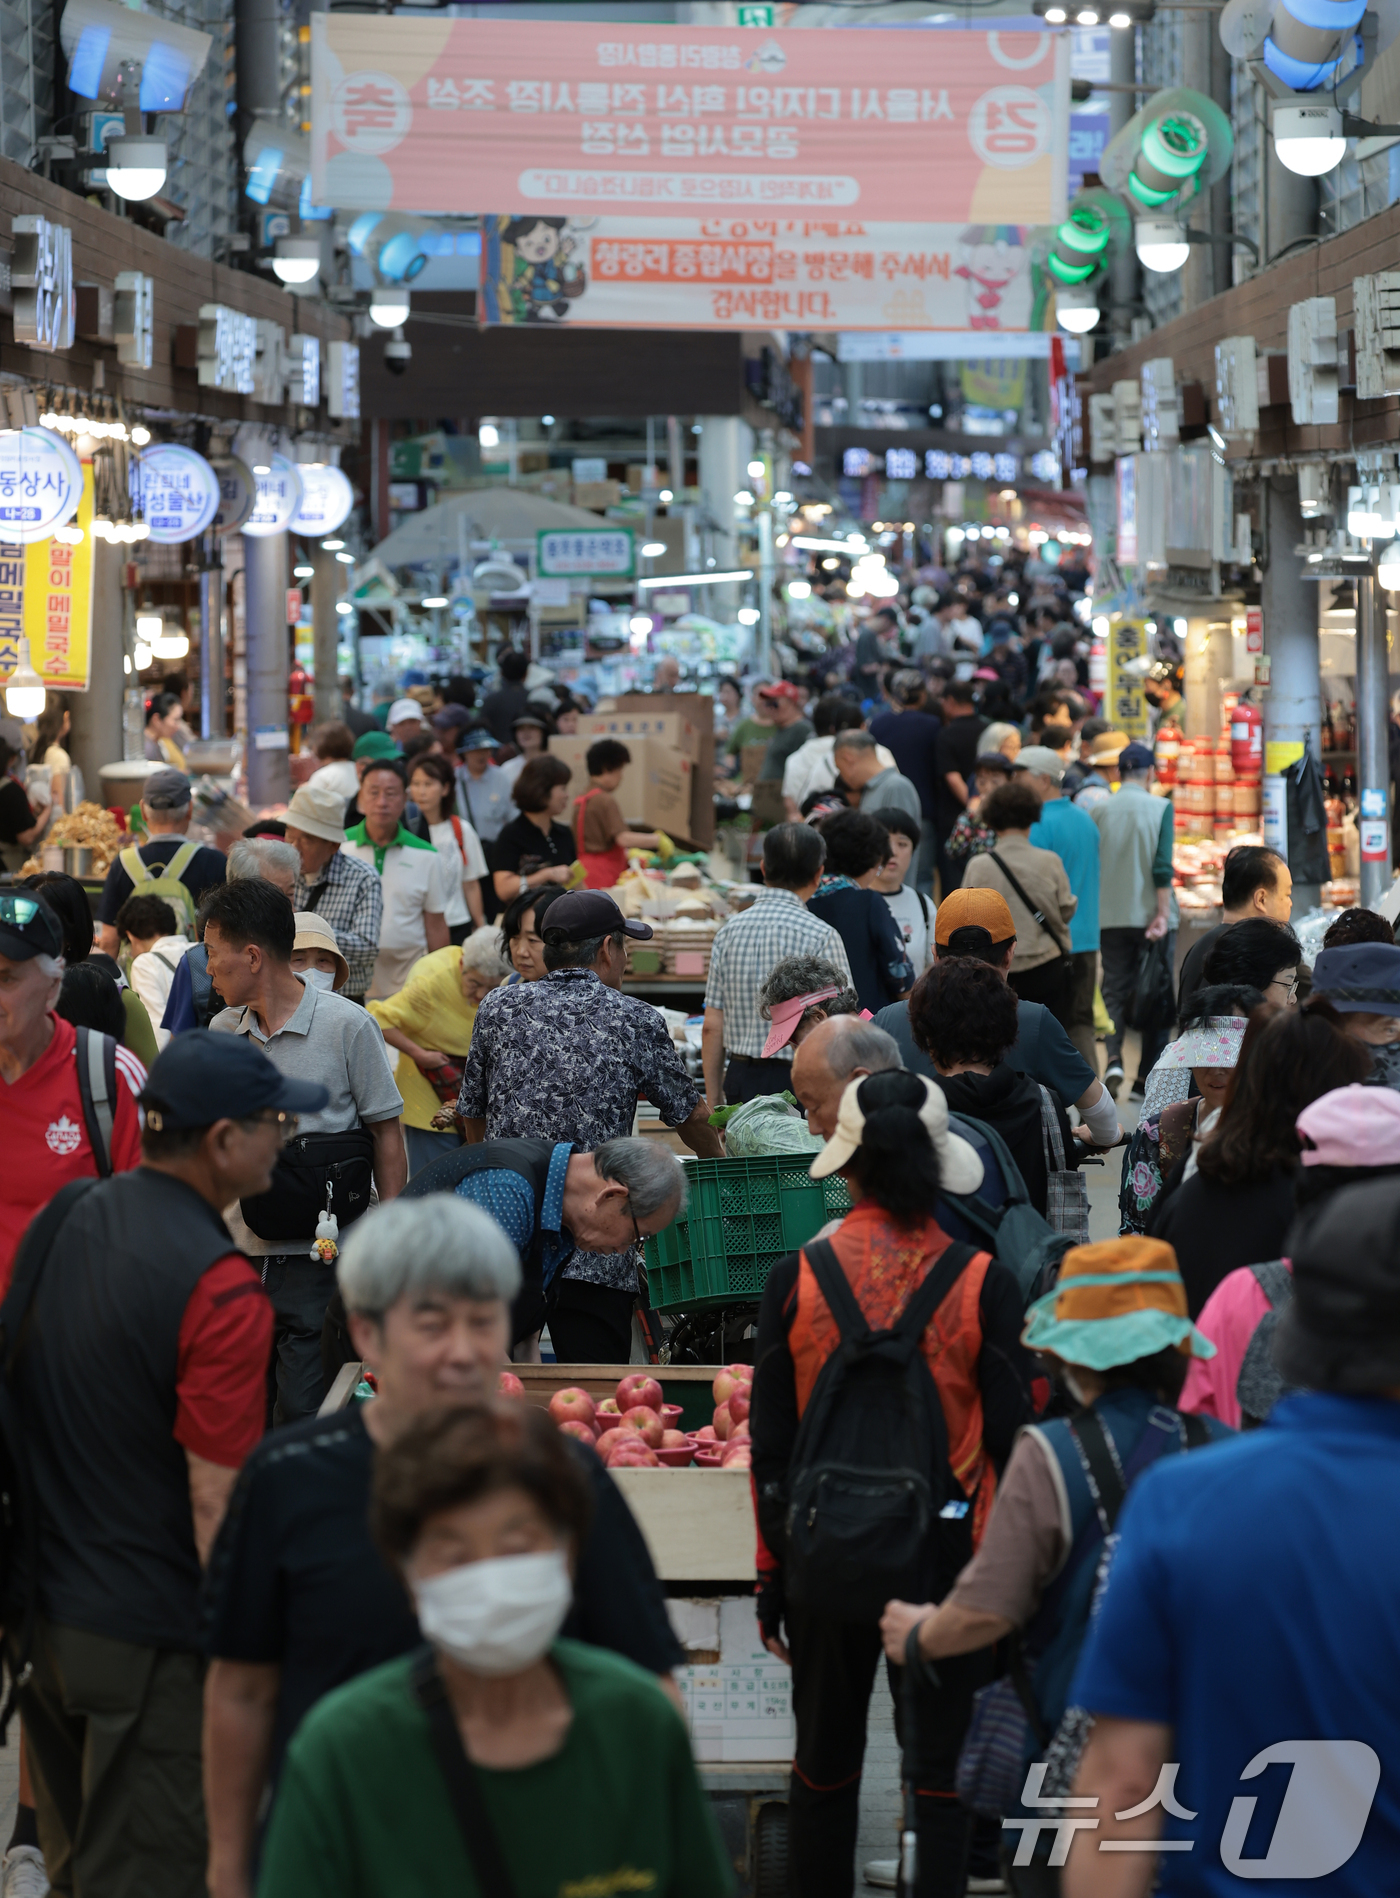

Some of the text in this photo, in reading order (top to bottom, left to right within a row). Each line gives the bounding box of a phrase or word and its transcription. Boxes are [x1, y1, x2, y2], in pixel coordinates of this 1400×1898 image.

[594, 241, 669, 277] 청량리
[803, 250, 875, 282] 방문해
[709, 289, 837, 320] 감사합니다.
[0, 470, 65, 498] 동상사
[46, 538, 72, 675] 말이 메밀국수
